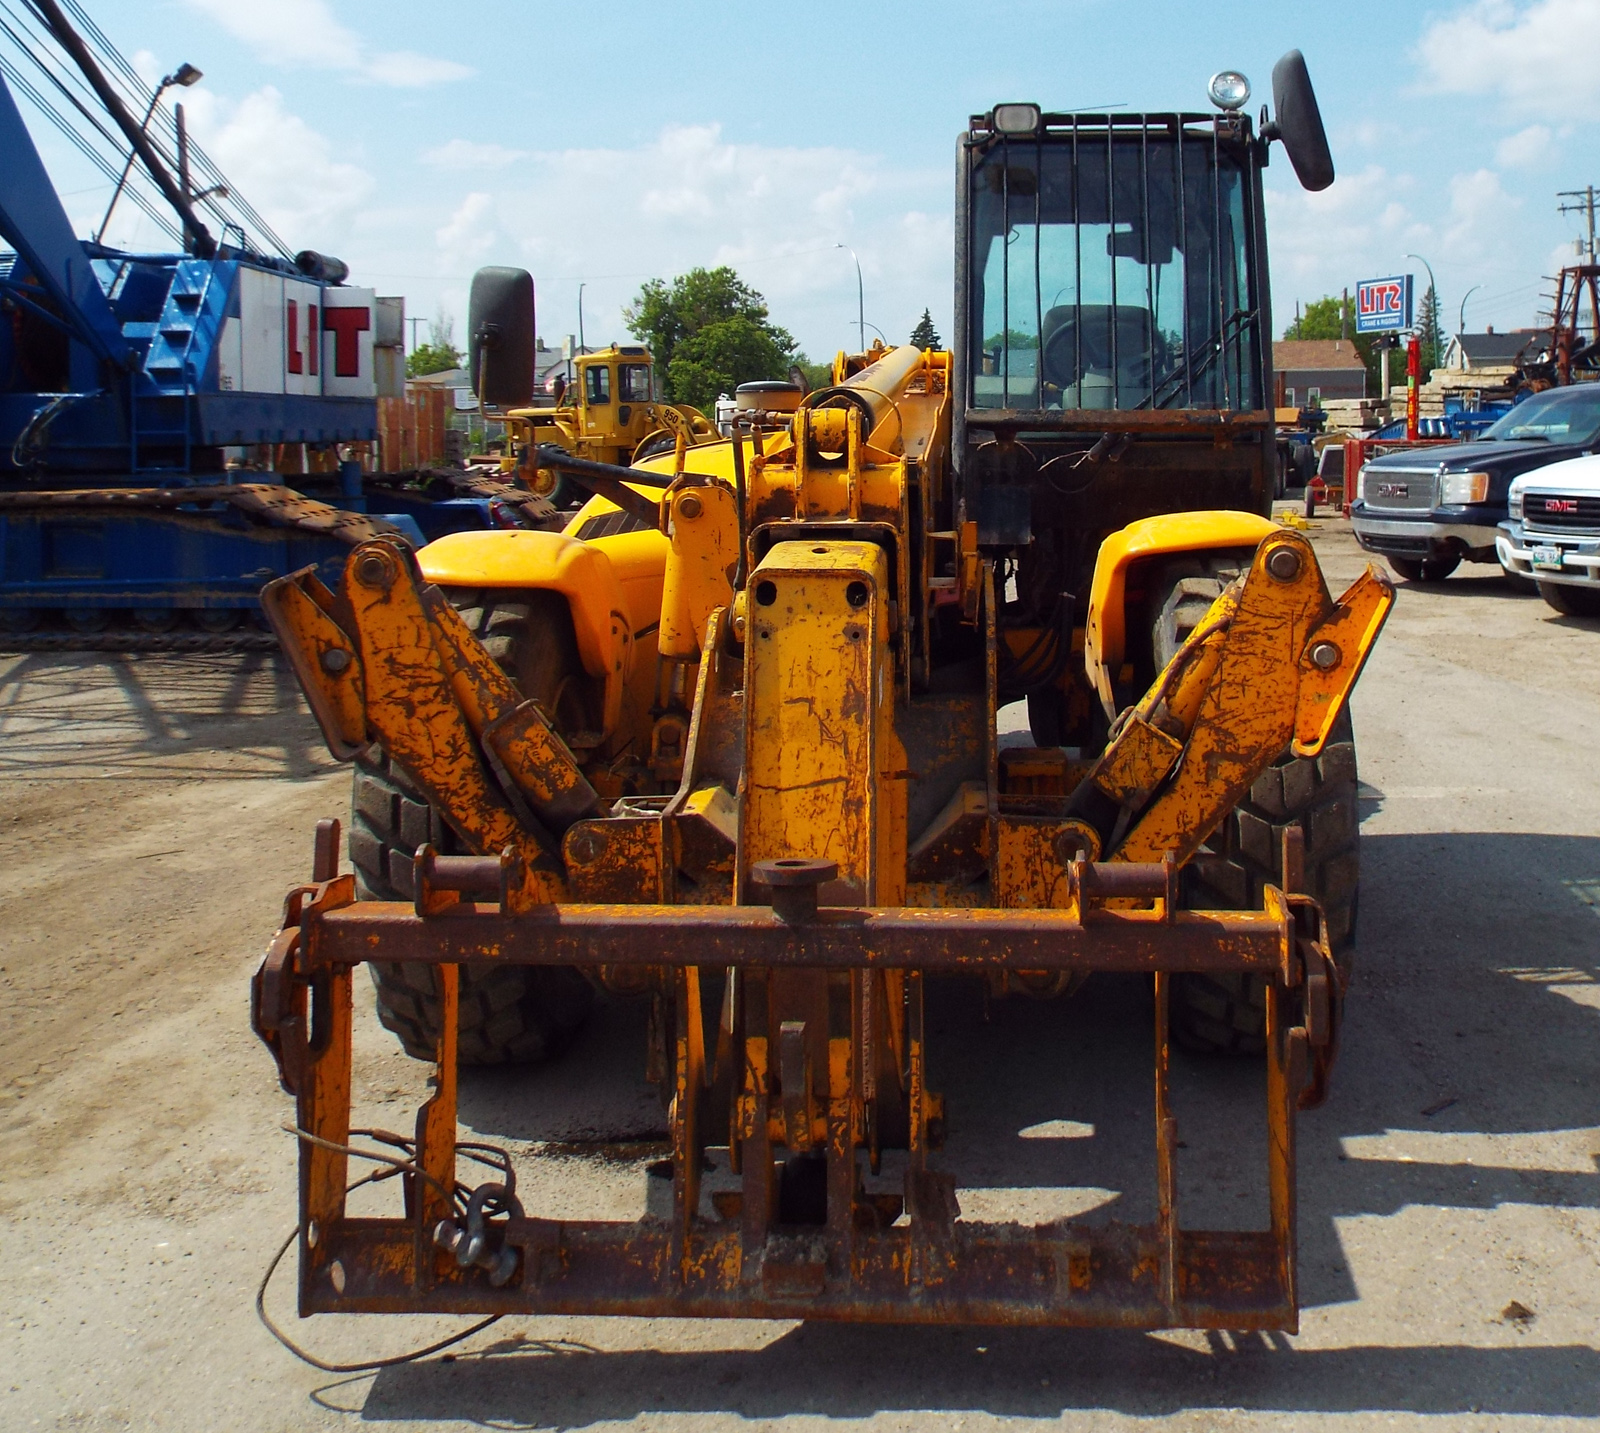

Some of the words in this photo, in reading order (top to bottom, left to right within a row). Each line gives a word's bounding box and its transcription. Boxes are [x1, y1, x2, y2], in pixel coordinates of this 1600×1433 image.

[1360, 284, 1400, 313] LITZ
[287, 299, 370, 377] LIT
[664, 409, 678, 423] 950
[1377, 484, 1408, 498] GMC
[1545, 500, 1577, 512] GMC
